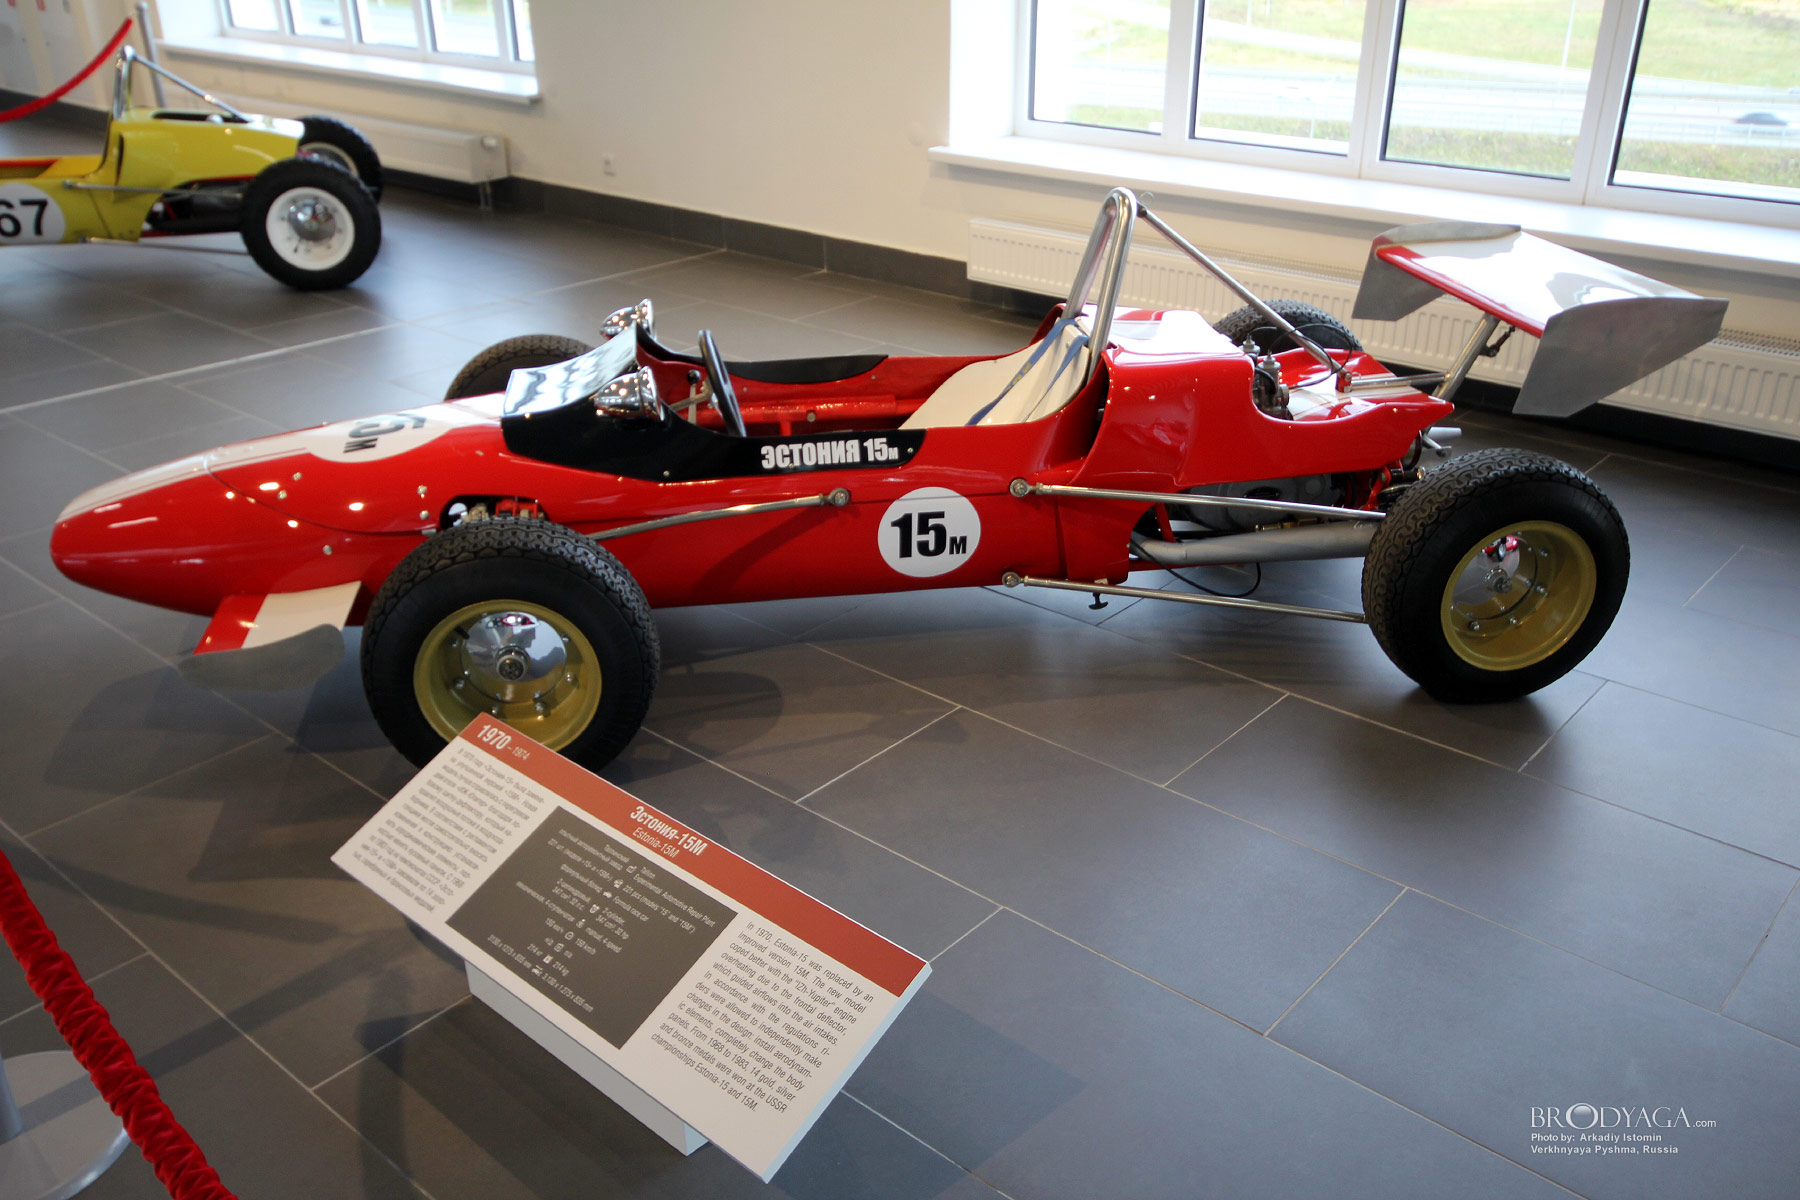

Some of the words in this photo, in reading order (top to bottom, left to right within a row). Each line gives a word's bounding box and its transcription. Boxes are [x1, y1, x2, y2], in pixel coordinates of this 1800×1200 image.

[0, 198, 48, 237] 67
[761, 439, 860, 469] ЭСТОНИЯ
[477, 724, 511, 749] 1970
[511, 746, 530, 760] 1974
[632, 826, 679, 857] Estonia-15M
[612, 895, 631, 911] Formula
[629, 907, 641, 917] race
[686, 906, 703, 919] Repair
[701, 915, 715, 927] Plant
[720, 952, 756, 978] overheating
[756, 974, 770, 985] due
[770, 982, 779, 991] to
[780, 988, 792, 999] the
[793, 996, 817, 1014] frontal
[816, 1011, 846, 1035] deflector,
[729, 942, 750, 957] coped
[747, 952, 768, 968] better
[766, 965, 781, 977] with
[780, 972, 792, 984] the
[833, 1006, 856, 1023] engine
[737, 931, 768, 953] improved
[768, 950, 791, 968] version
[793, 965, 810, 979] 15M.
[812, 975, 825, 988] The
[826, 986, 842, 998] new
[843, 996, 866, 1013] model
[745, 921, 754, 930] In
[755, 927, 772, 942] 1970,
[773, 937, 808, 962] Estonia-15
[808, 960, 822, 971] was
[822, 969, 853, 989] replaced
[852, 985, 863, 996] by
[862, 993, 873, 1002] an
[686, 992, 712, 1011] changes
[711, 1007, 720, 1016] in
[718, 1012, 731, 1024] the
[753, 1035, 775, 1053] install
[773, 1050, 811, 1077] aerodynam-
[695, 981, 710, 994] ders
[709, 991, 725, 1004] were
[725, 1001, 751, 1020] allowed
[749, 1016, 758, 1025] to
[758, 1022, 803, 1056] independently
[802, 1052, 821, 1068] make
[703, 970, 712, 979] In
[713, 978, 748, 1003] accordance
[750, 1002, 765, 1014] with
[767, 1012, 779, 1023] the
[781, 1022, 818, 1048] regulations
[820, 1047, 832, 1057] ri-
[712, 961, 731, 976] which
[729, 973, 754, 990] guided
[752, 987, 777, 1006] airflows
[777, 1001, 791, 1014] into
[790, 1011, 803, 1022] the
[802, 1019, 814, 1028] air
[812, 1024, 837, 1045] intakes.
[651, 1033, 695, 1067] championships
[694, 1062, 730, 1090] Estonia-15
[726, 1087, 743, 1099] and
[740, 1095, 758, 1111] 15M.
[659, 1022, 674, 1034] and
[671, 1029, 693, 1048] bronze
[692, 1045, 715, 1064] medals
[715, 1061, 732, 1075] were
[731, 1072, 746, 1086] won
[745, 1082, 755, 1091] at
[753, 1086, 765, 1099] the
[765, 1094, 787, 1113] USSR
[667, 1012, 689, 1030] panels.
[689, 1025, 707, 1041] From
[707, 1037, 724, 1052] 1968
[722, 1048, 731, 1057] to
[731, 1053, 749, 1071] 1983,
[750, 1066, 761, 1077] 14
[756, 1074, 776, 1090] gold,
[775, 1085, 795, 1101] silver
[677, 1002, 685, 1010] ic
[685, 1007, 713, 1030] elements,
[714, 1027, 749, 1054] completely
[748, 1050, 773, 1069] change
[773, 1065, 786, 1078] the
[785, 1073, 804, 1091] body
